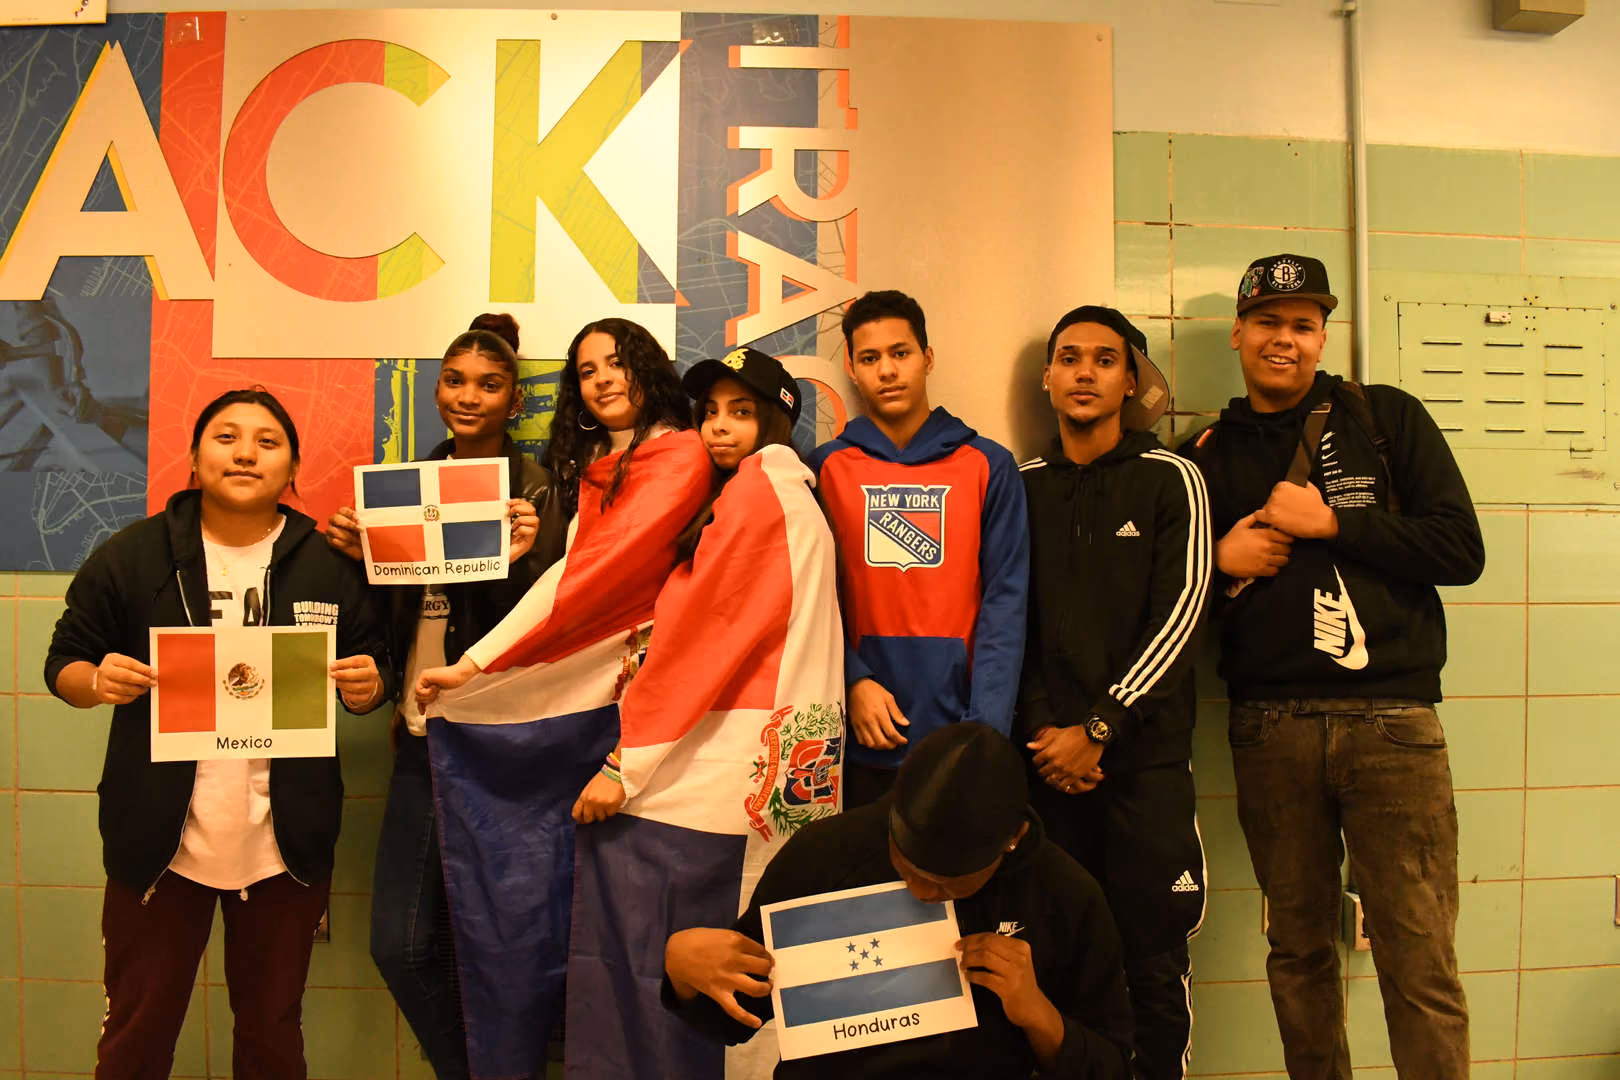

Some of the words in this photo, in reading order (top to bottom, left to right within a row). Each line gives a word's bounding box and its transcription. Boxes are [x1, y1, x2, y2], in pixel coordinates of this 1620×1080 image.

[1282, 266, 1290, 282] B
[870, 494, 900, 508] NEW
[904, 494, 940, 508] YORK
[879, 512, 937, 560] RANGERS
[374, 564, 440, 576] Dominican
[445, 559, 501, 575] Republic
[293, 601, 339, 616] BUILDING
[422, 600, 448, 611] RGY
[1313, 588, 1347, 657] NIKE
[216, 735, 273, 750] Mexico
[998, 921, 1018, 933] NIKE
[833, 1012, 920, 1040] Honduras
